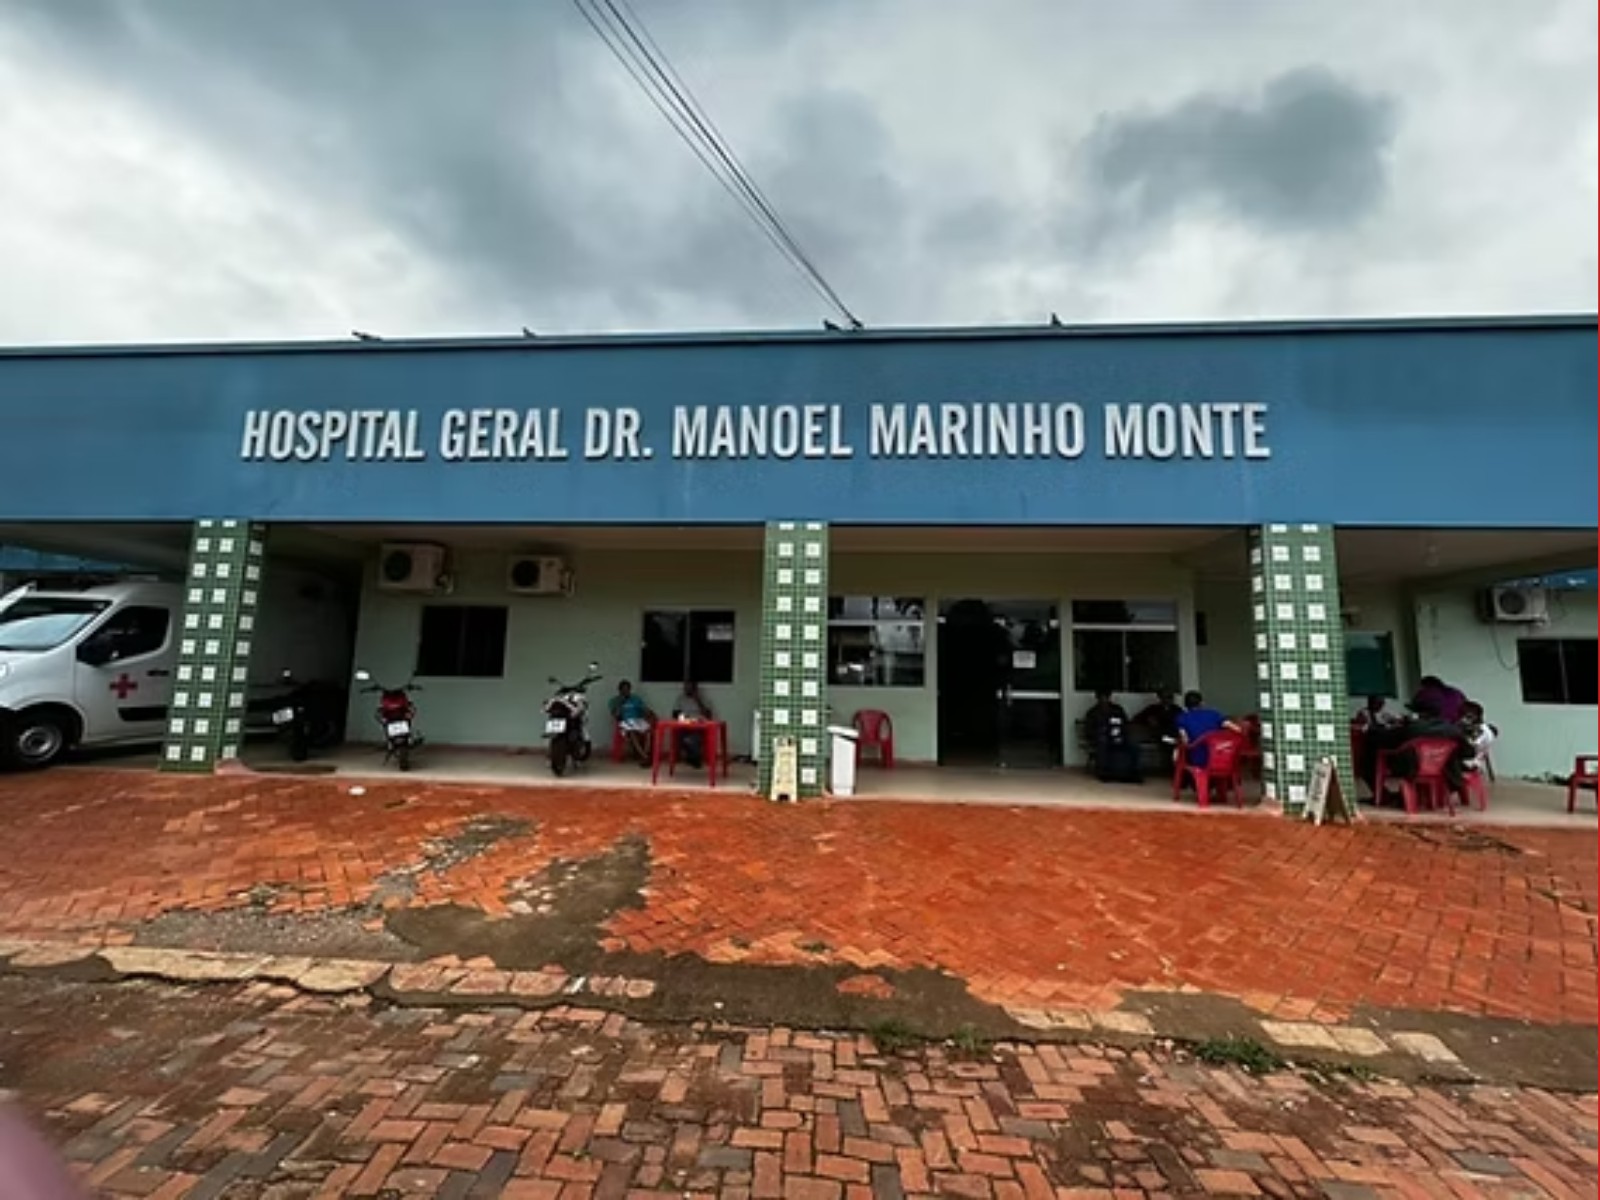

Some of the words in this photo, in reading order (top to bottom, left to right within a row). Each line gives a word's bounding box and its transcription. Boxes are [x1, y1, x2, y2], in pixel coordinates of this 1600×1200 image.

[241, 410, 424, 459] HOSPITAL
[440, 408, 567, 459] GERAL
[584, 408, 652, 457] DR.
[672, 405, 853, 457] MANOEL
[871, 403, 1084, 457] MARINHO
[1105, 403, 1270, 457] MONTE
